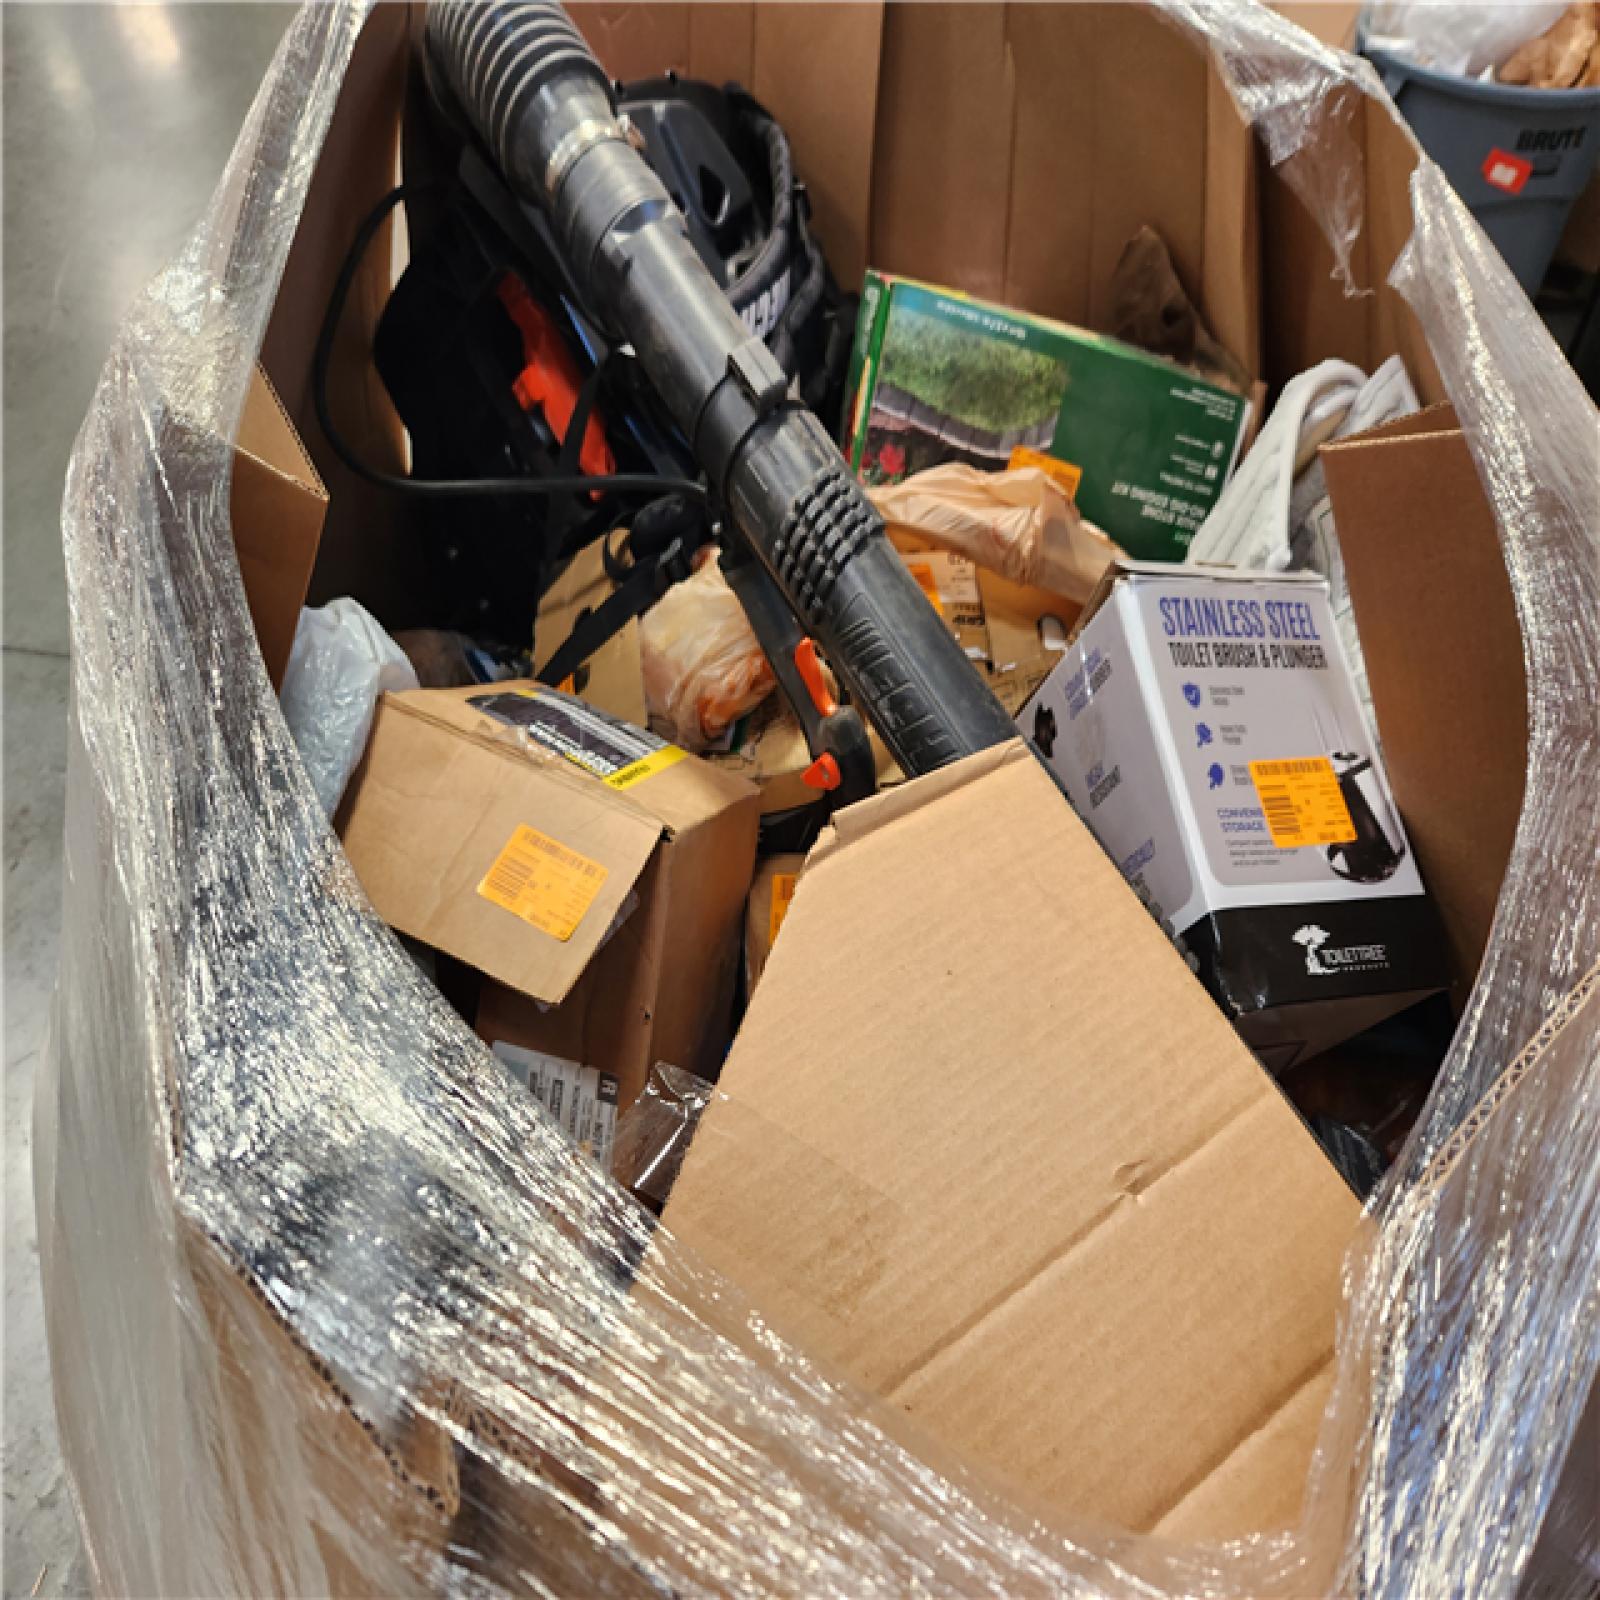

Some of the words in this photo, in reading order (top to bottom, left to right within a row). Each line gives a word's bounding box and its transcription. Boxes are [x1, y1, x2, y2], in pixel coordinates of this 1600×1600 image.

[1159, 596, 1265, 638] STAINLESS
[1264, 601, 1320, 640] STEEL
[1167, 642, 1212, 668] TOILET
[1212, 642, 1258, 668] BRUSH
[1269, 644, 1328, 670] PLUNGER
